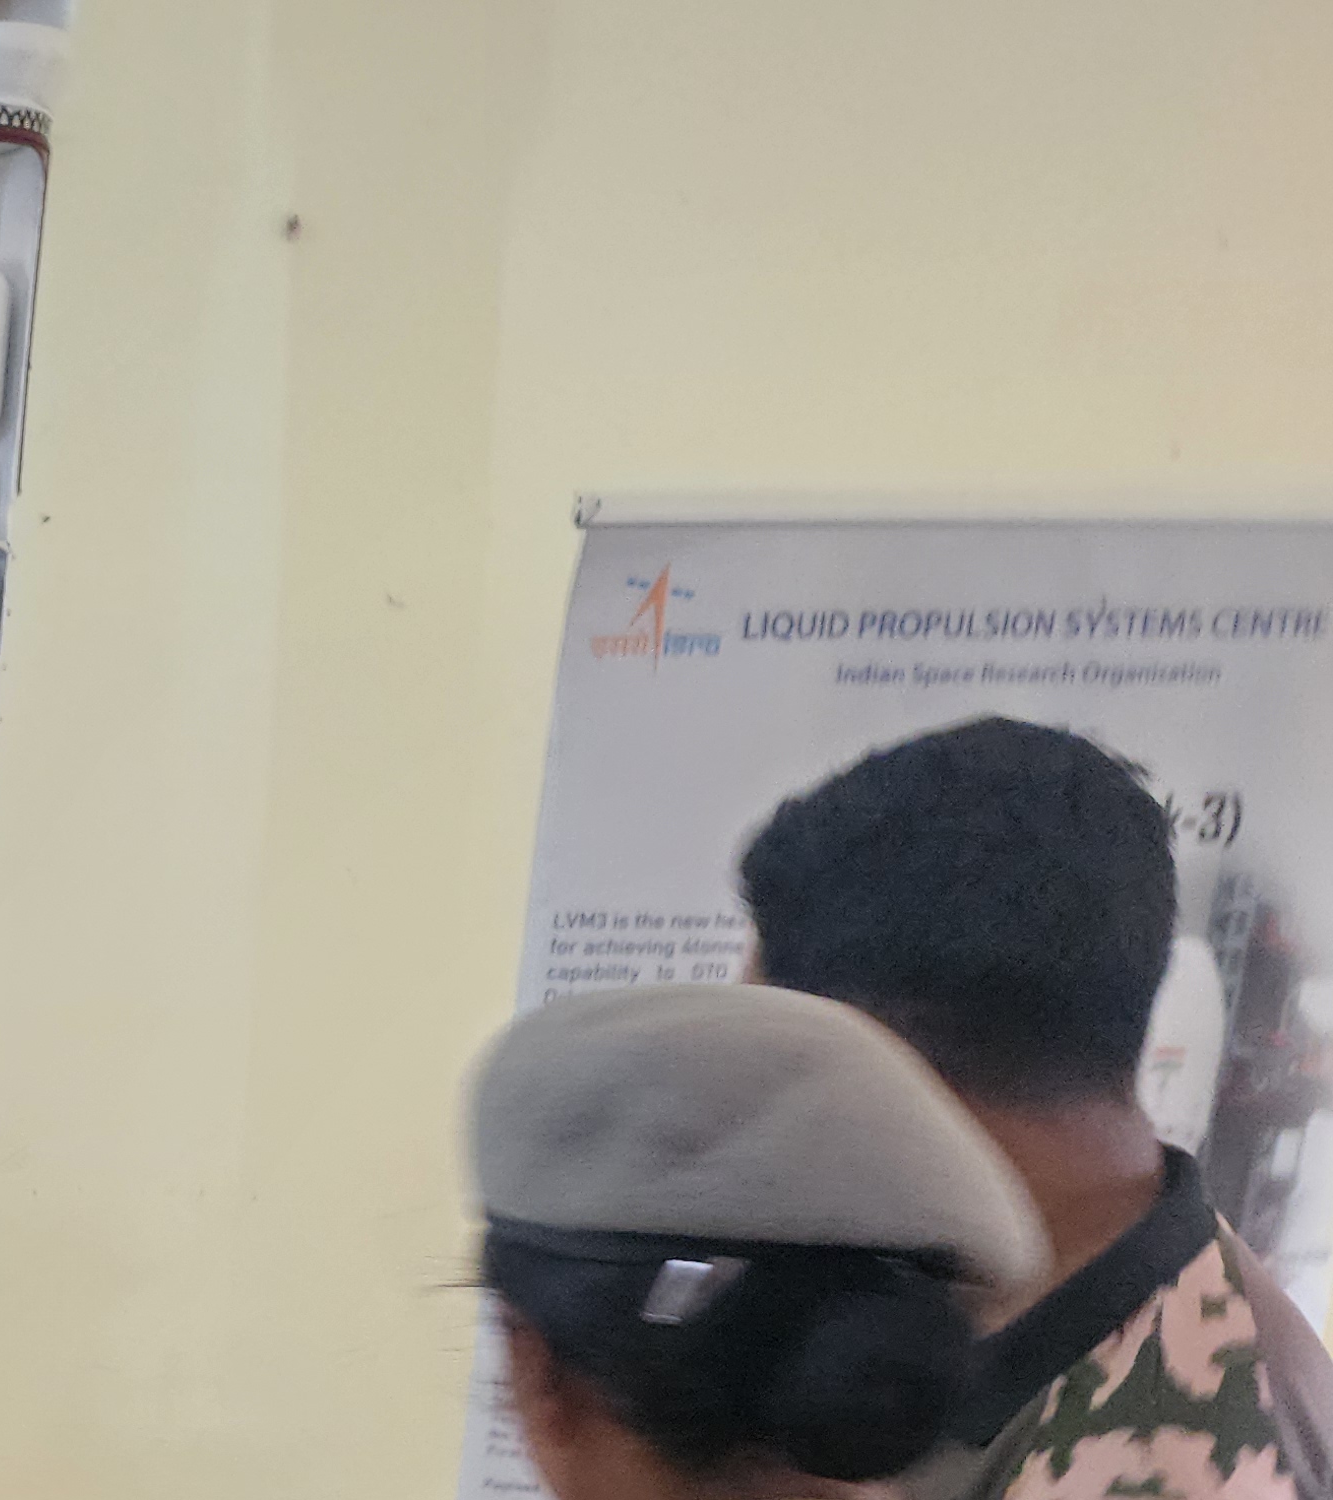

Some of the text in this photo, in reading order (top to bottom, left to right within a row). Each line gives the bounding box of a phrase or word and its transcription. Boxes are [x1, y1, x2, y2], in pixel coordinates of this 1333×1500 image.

[742, 608, 850, 641] LIQUID
[857, 608, 1056, 641] PROPULSION
[1065, 605, 1203, 639] SYSTEMS
[836, 662, 906, 684] Indian
[911, 661, 975, 689] Space
[634, 912, 666, 930] the
